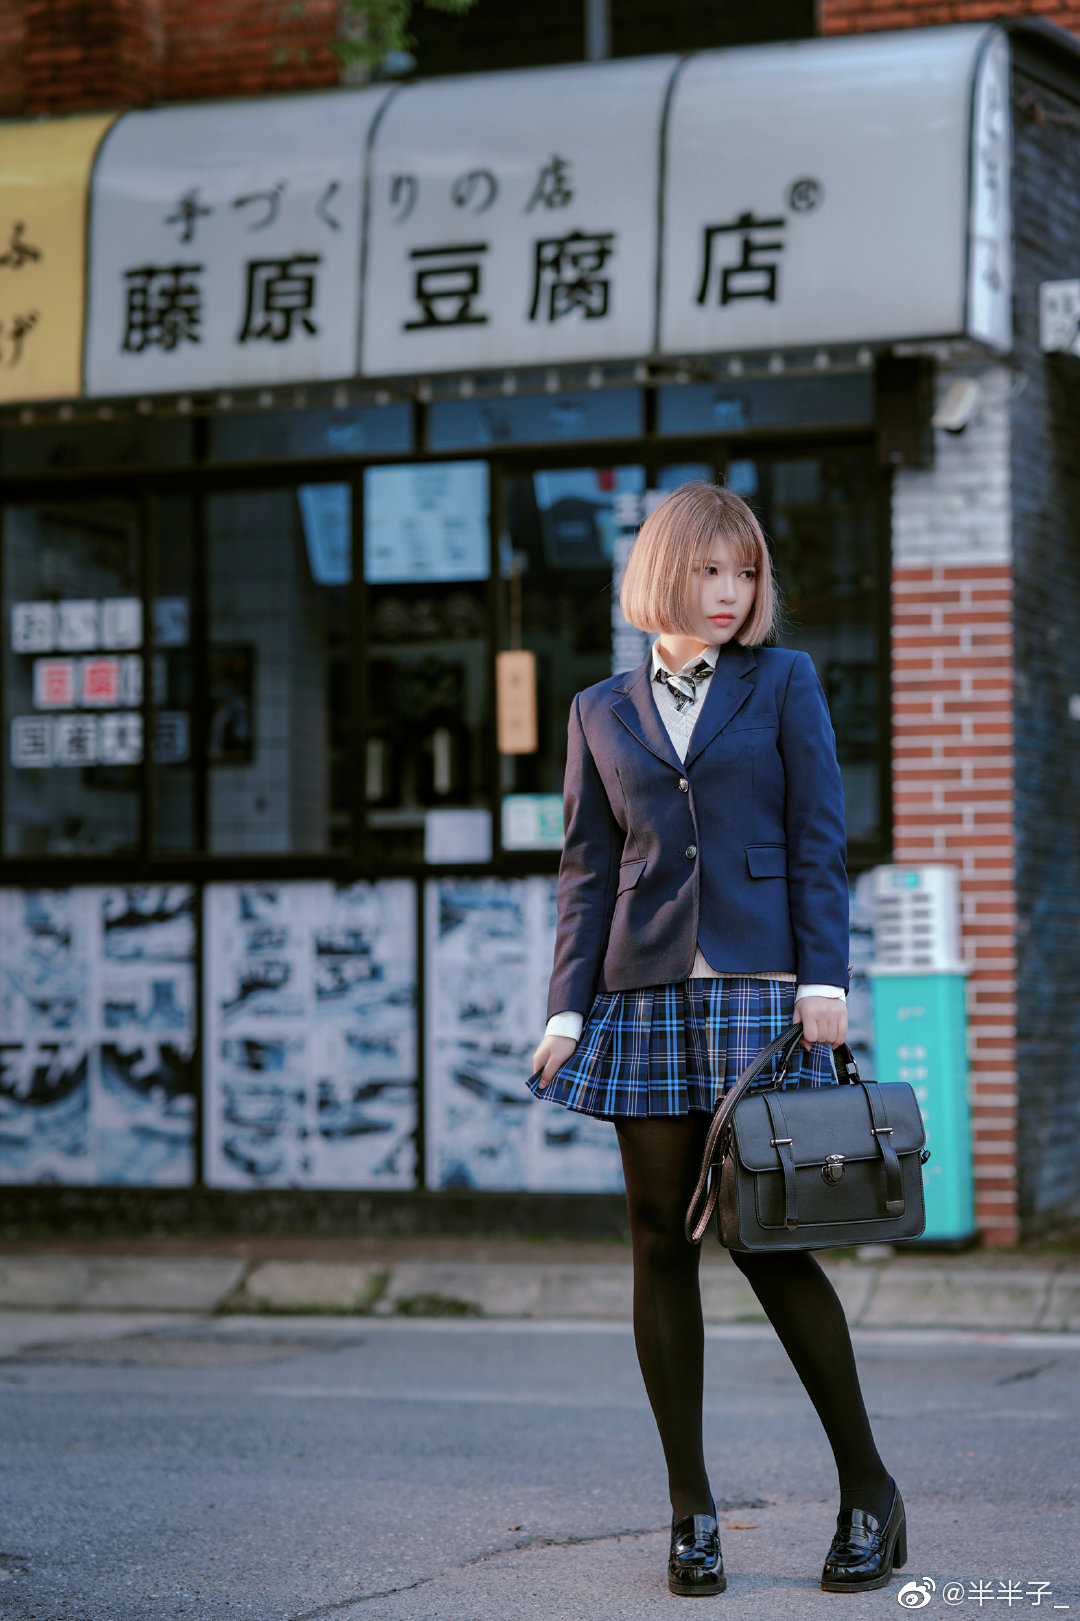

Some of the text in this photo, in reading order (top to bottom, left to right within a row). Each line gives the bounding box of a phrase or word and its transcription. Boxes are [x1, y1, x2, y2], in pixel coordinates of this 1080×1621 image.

[164, 153, 576, 246] 手づくりの店
[121, 211, 788, 356] 藤原豆腐店
